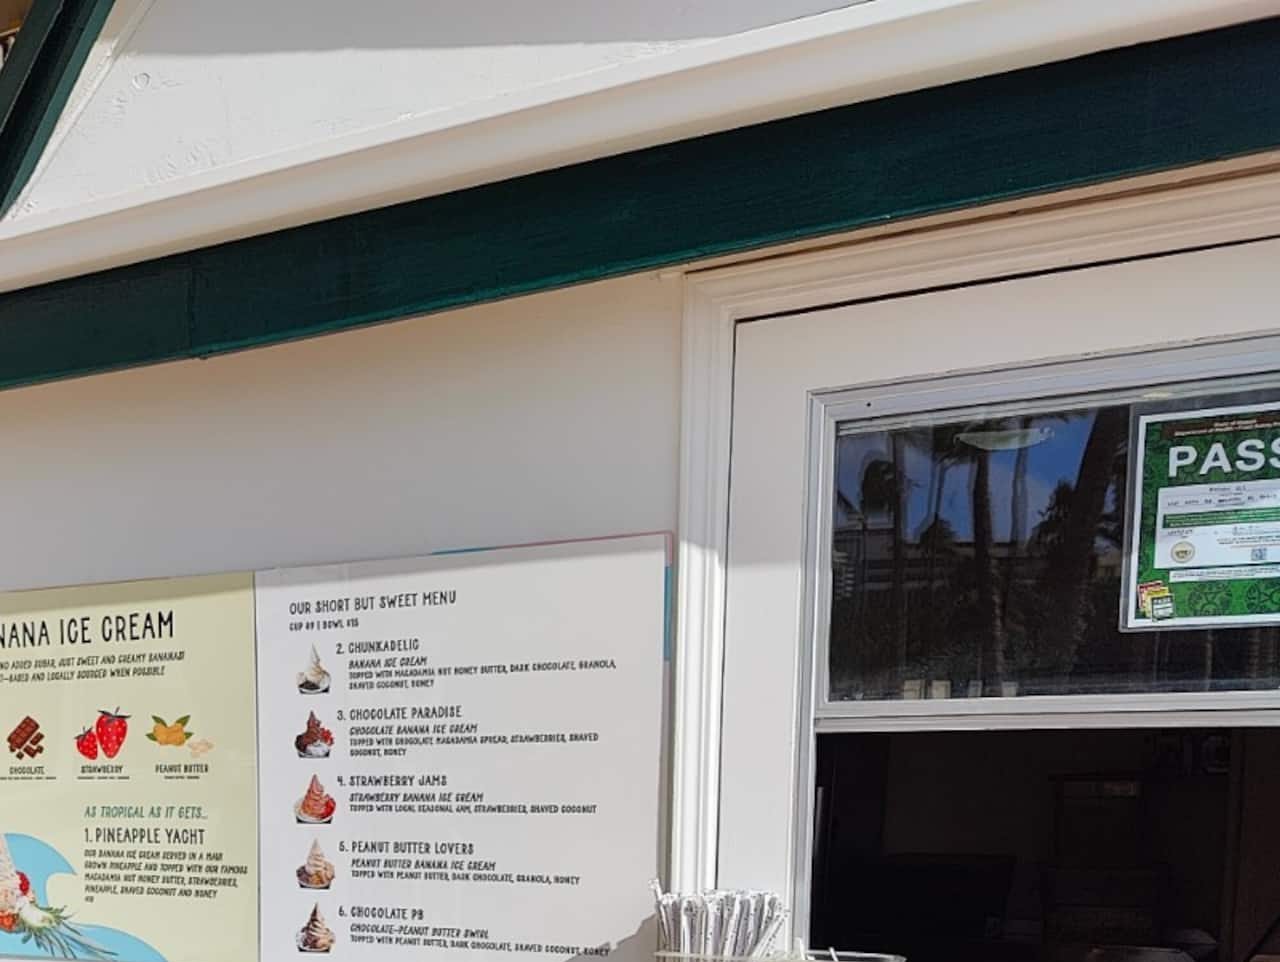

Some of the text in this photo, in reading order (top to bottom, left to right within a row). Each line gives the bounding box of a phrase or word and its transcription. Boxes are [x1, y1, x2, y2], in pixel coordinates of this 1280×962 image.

[289, 590, 457, 615] OUR SHORT BUT SWEET MENU
[60, 617, 91, 645] ICE
[102, 610, 173, 642] CREAM
[289, 622, 304, 631] CUP
[322, 619, 344, 629] BOWL
[336, 638, 420, 654] 2. CHUNKADELIC
[348, 656, 428, 669] BANANA ICE CREAM
[337, 705, 462, 720] 3. CHOCOLATE PARADISE
[350, 724, 478, 736] CHOCOLATE BANANA ICE CREAM
[337, 775, 447, 786] 4. STRAWBERRY JAMS
[349, 792, 484, 802] STRAWBERRY BANANA ICE CREAM
[84, 806, 97, 819] AS
[101, 806, 144, 819] TROPICAL
[148, 806, 162, 819] AS
[165, 806, 176, 819] IT
[84, 828, 205, 844] 1. PINEAPPLE YACHT
[339, 841, 474, 856] 5. PEANUT BUTTER LOVERS
[352, 859, 497, 871] PEANUT BUTTER BANANA ICE CREAM
[339, 906, 424, 920] 6. CHOCOLATE PB
[432, 927, 462, 938] BUTTER
[464, 928, 489, 939] SWIRL
